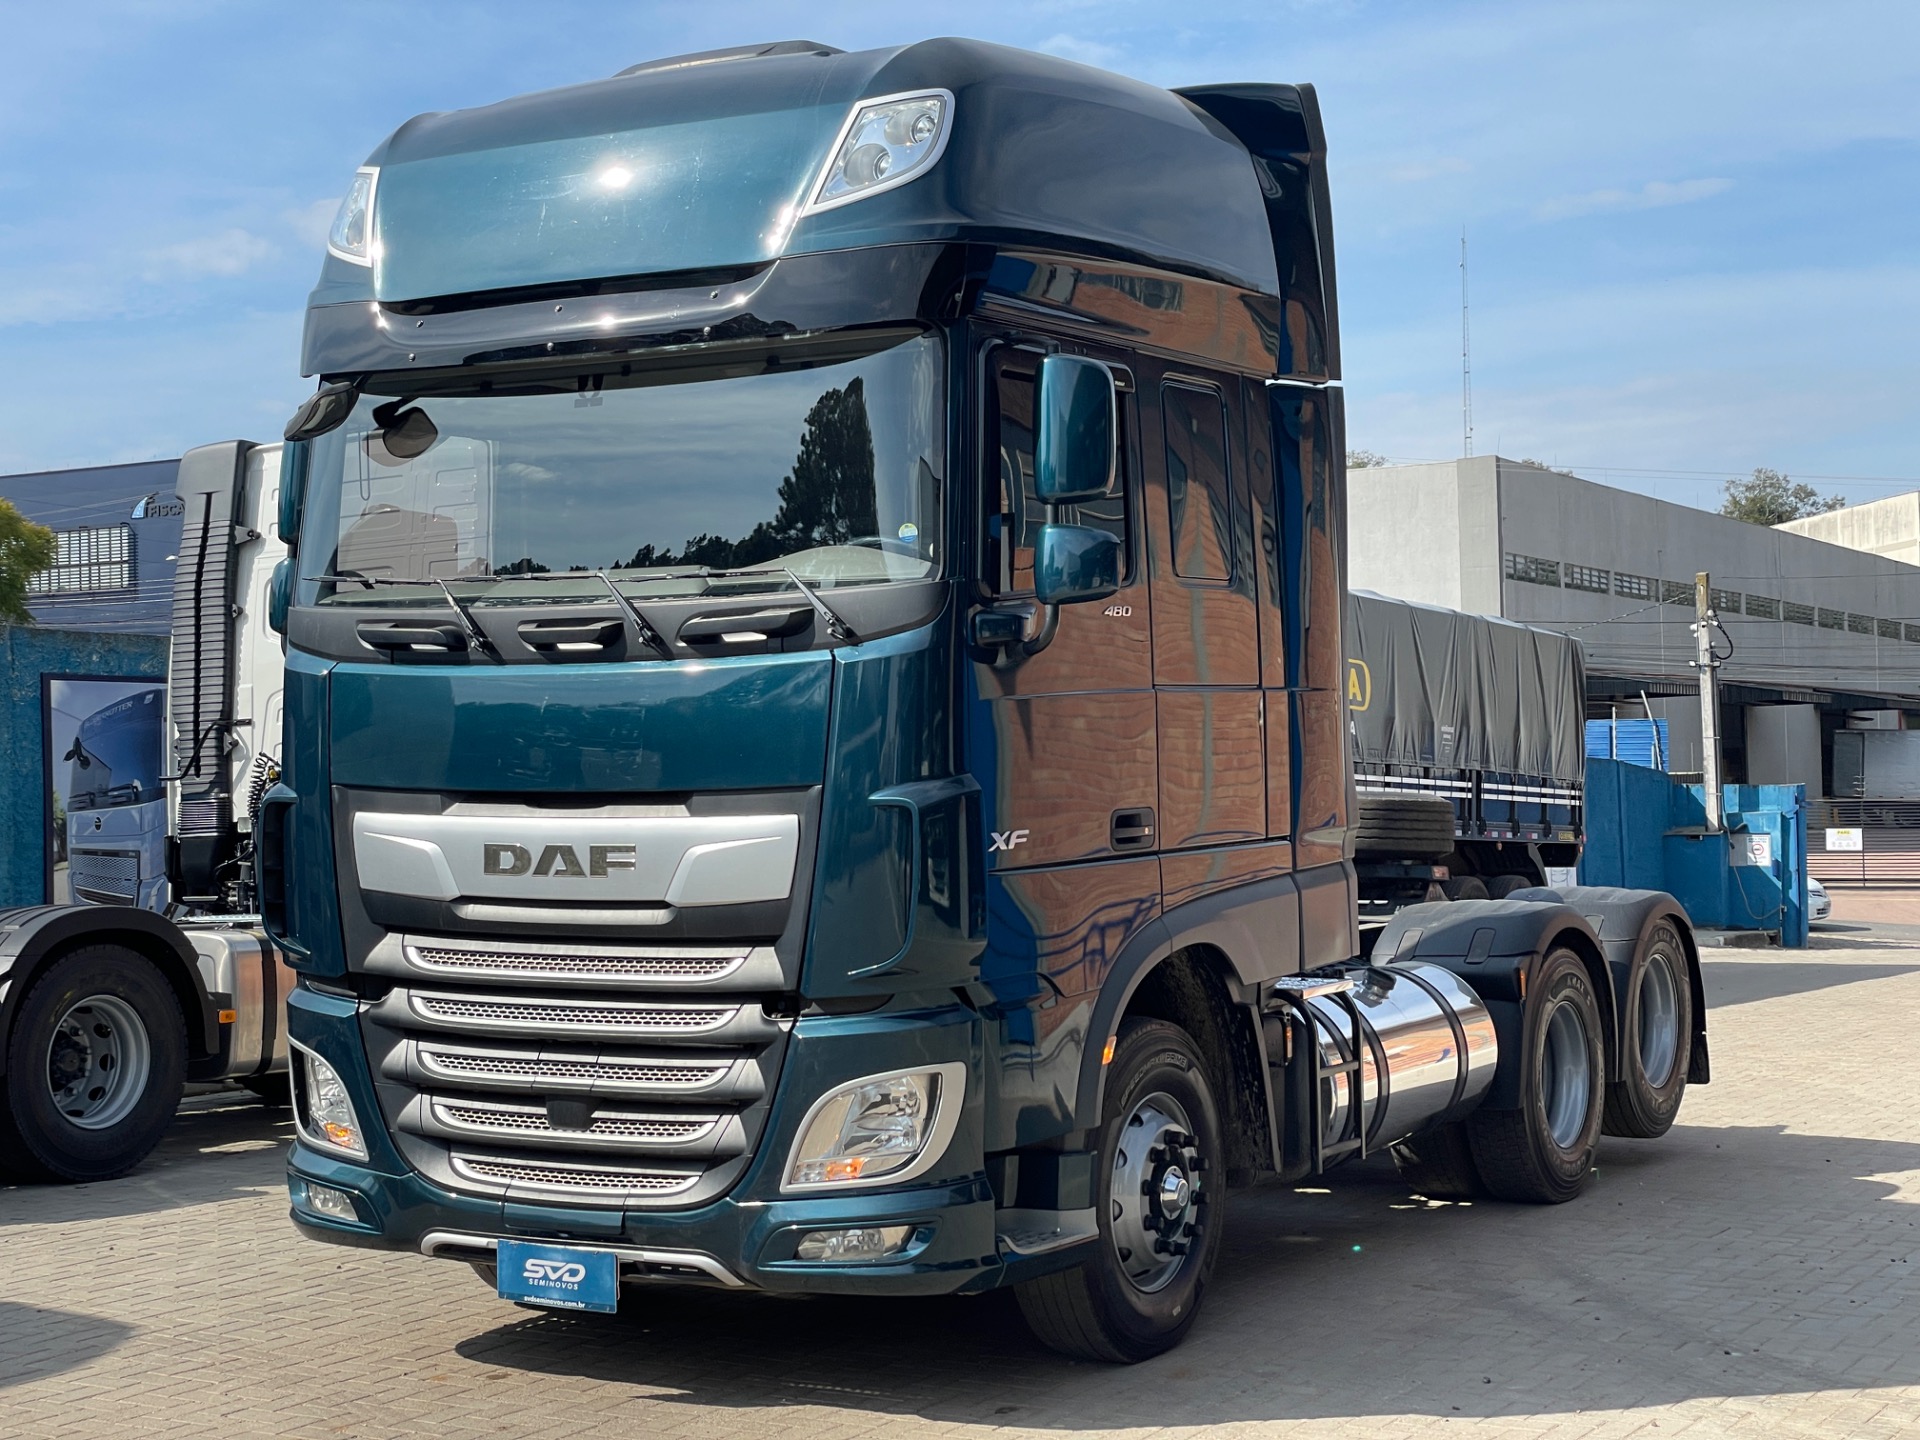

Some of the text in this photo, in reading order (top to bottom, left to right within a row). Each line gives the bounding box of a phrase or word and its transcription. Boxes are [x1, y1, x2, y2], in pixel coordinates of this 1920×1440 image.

[1103, 605, 1132, 617] 480
[988, 830, 1030, 852] XF
[483, 842, 637, 878] DAF
[523, 1258, 587, 1283] SVD
[528, 1278, 579, 1291] SEMINOVOS
[523, 1295, 586, 1308] svdseminovos.com.br
